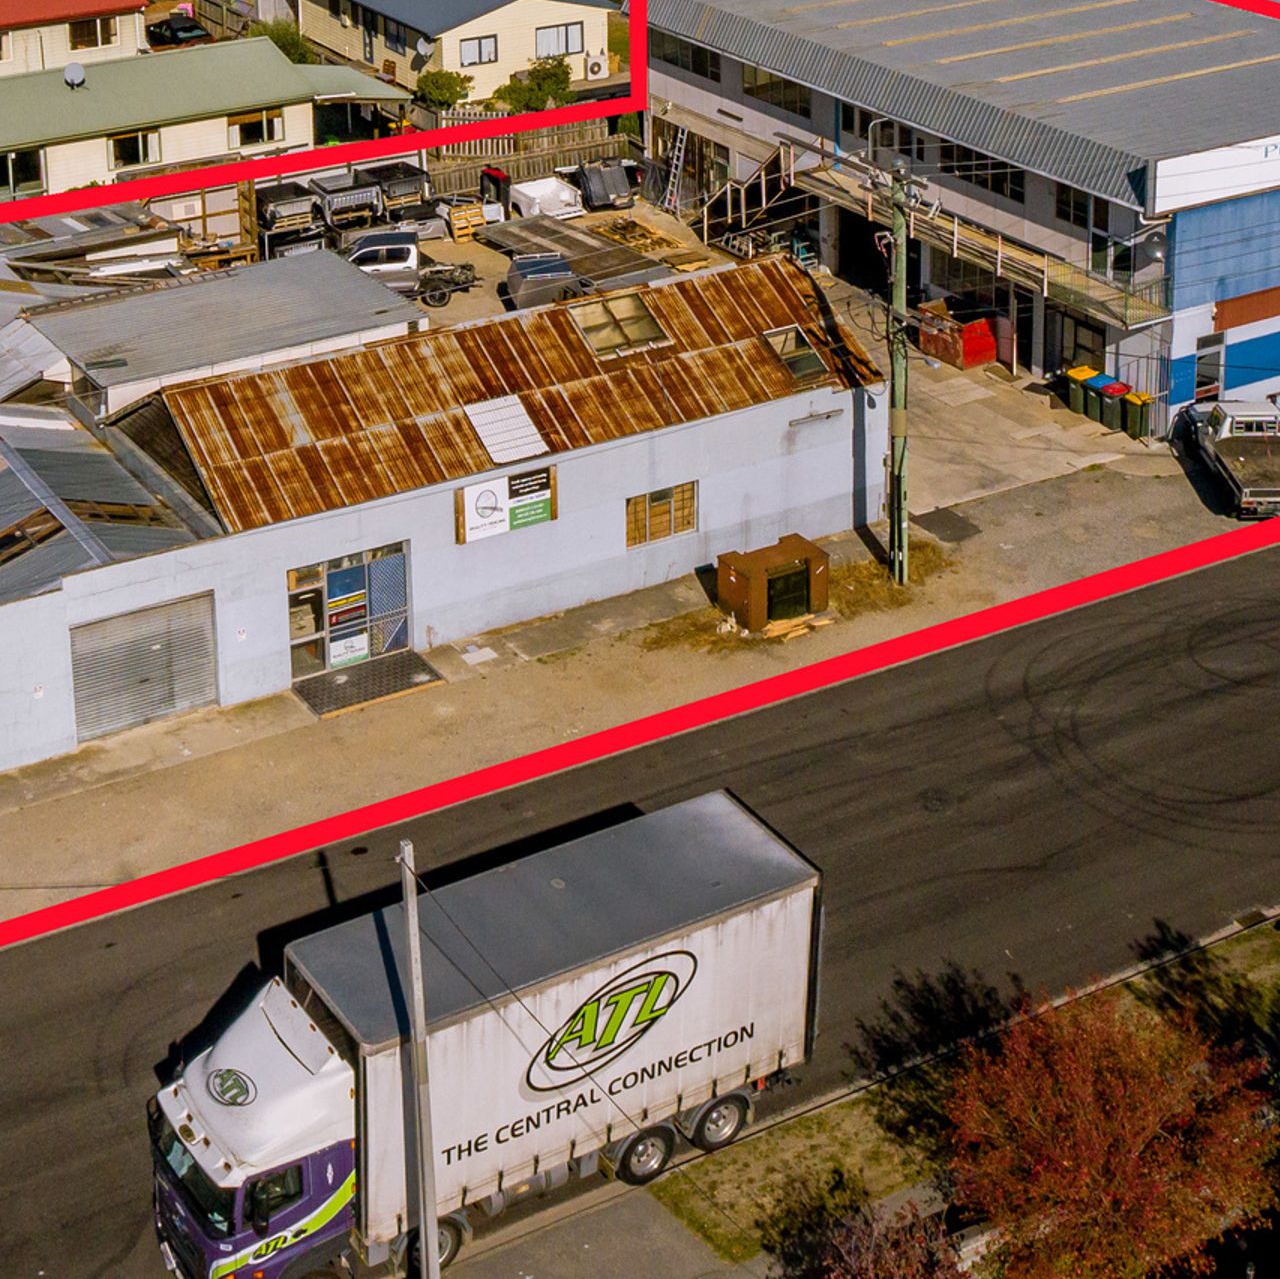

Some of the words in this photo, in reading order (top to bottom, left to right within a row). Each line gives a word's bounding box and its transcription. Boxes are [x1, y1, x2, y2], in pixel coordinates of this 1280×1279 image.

[544, 972, 671, 1064] ATL
[442, 1132, 489, 1166] THE
[495, 1087, 601, 1144] CENTRAL
[608, 1022, 755, 1096] CONNECTION
[253, 1234, 287, 1260] ATL
